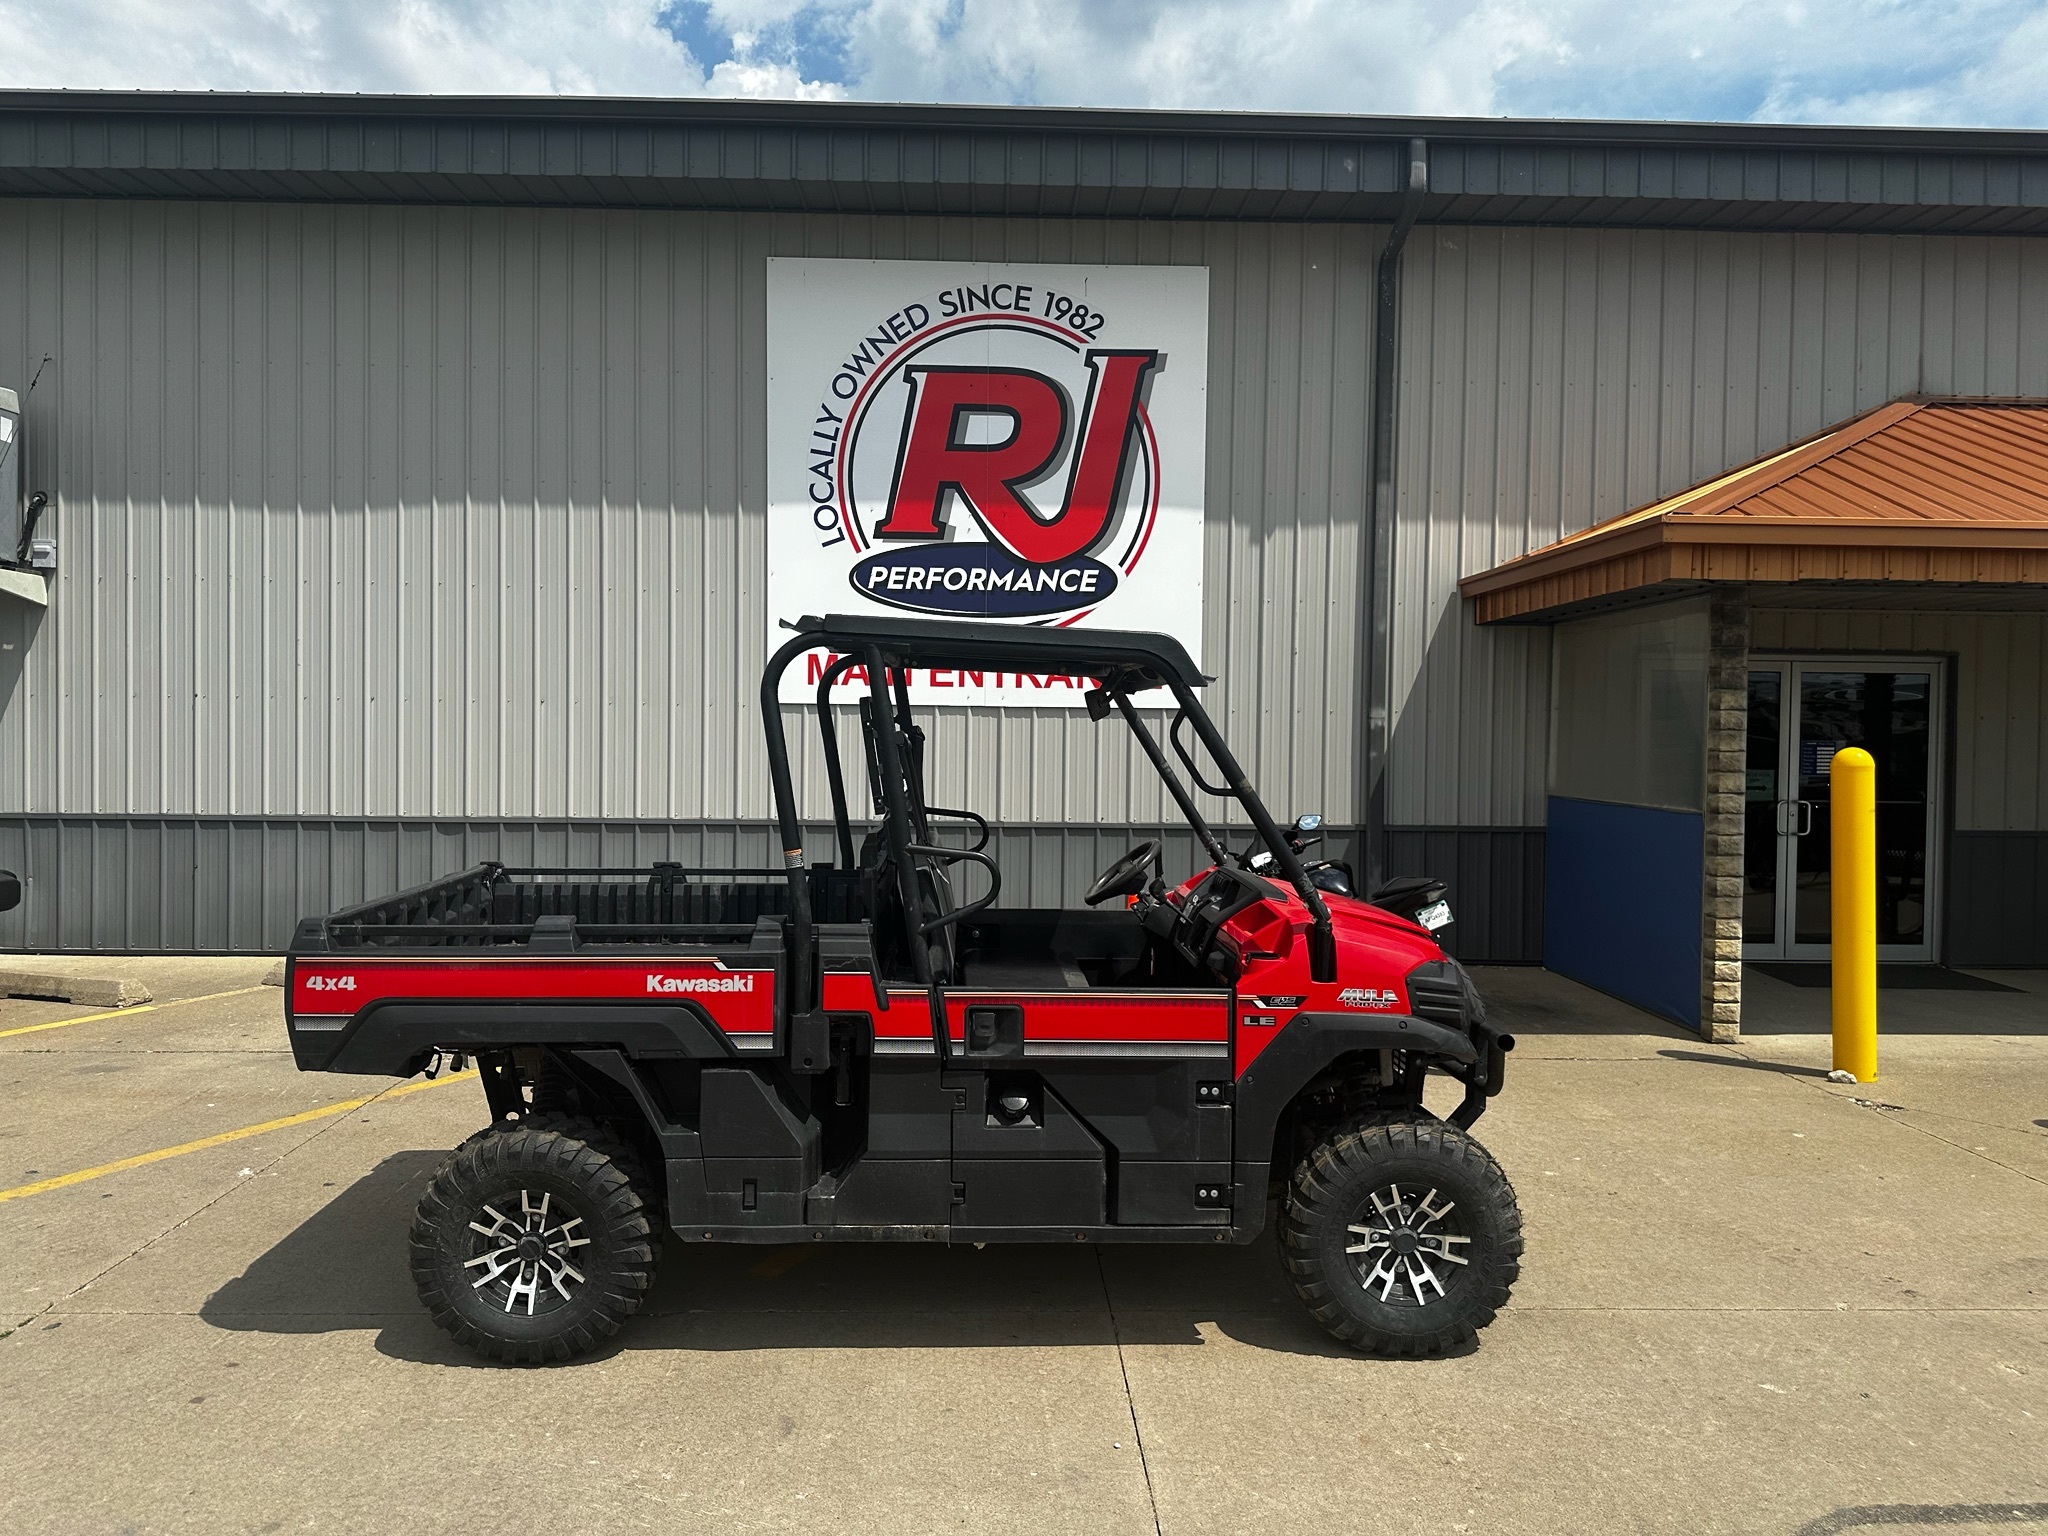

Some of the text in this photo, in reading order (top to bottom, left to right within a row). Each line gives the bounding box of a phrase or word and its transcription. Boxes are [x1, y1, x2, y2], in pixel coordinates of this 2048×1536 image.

[808, 284, 1105, 548] LOCALLY OWNED SINCE 1982
[874, 349, 1160, 564] RJ
[867, 566, 1099, 593] PERFORMANCE
[306, 976, 357, 991] 4x4
[646, 974, 754, 992] Kawasaki
[1336, 988, 1400, 1003] MULE
[1243, 1016, 1275, 1026] LE
